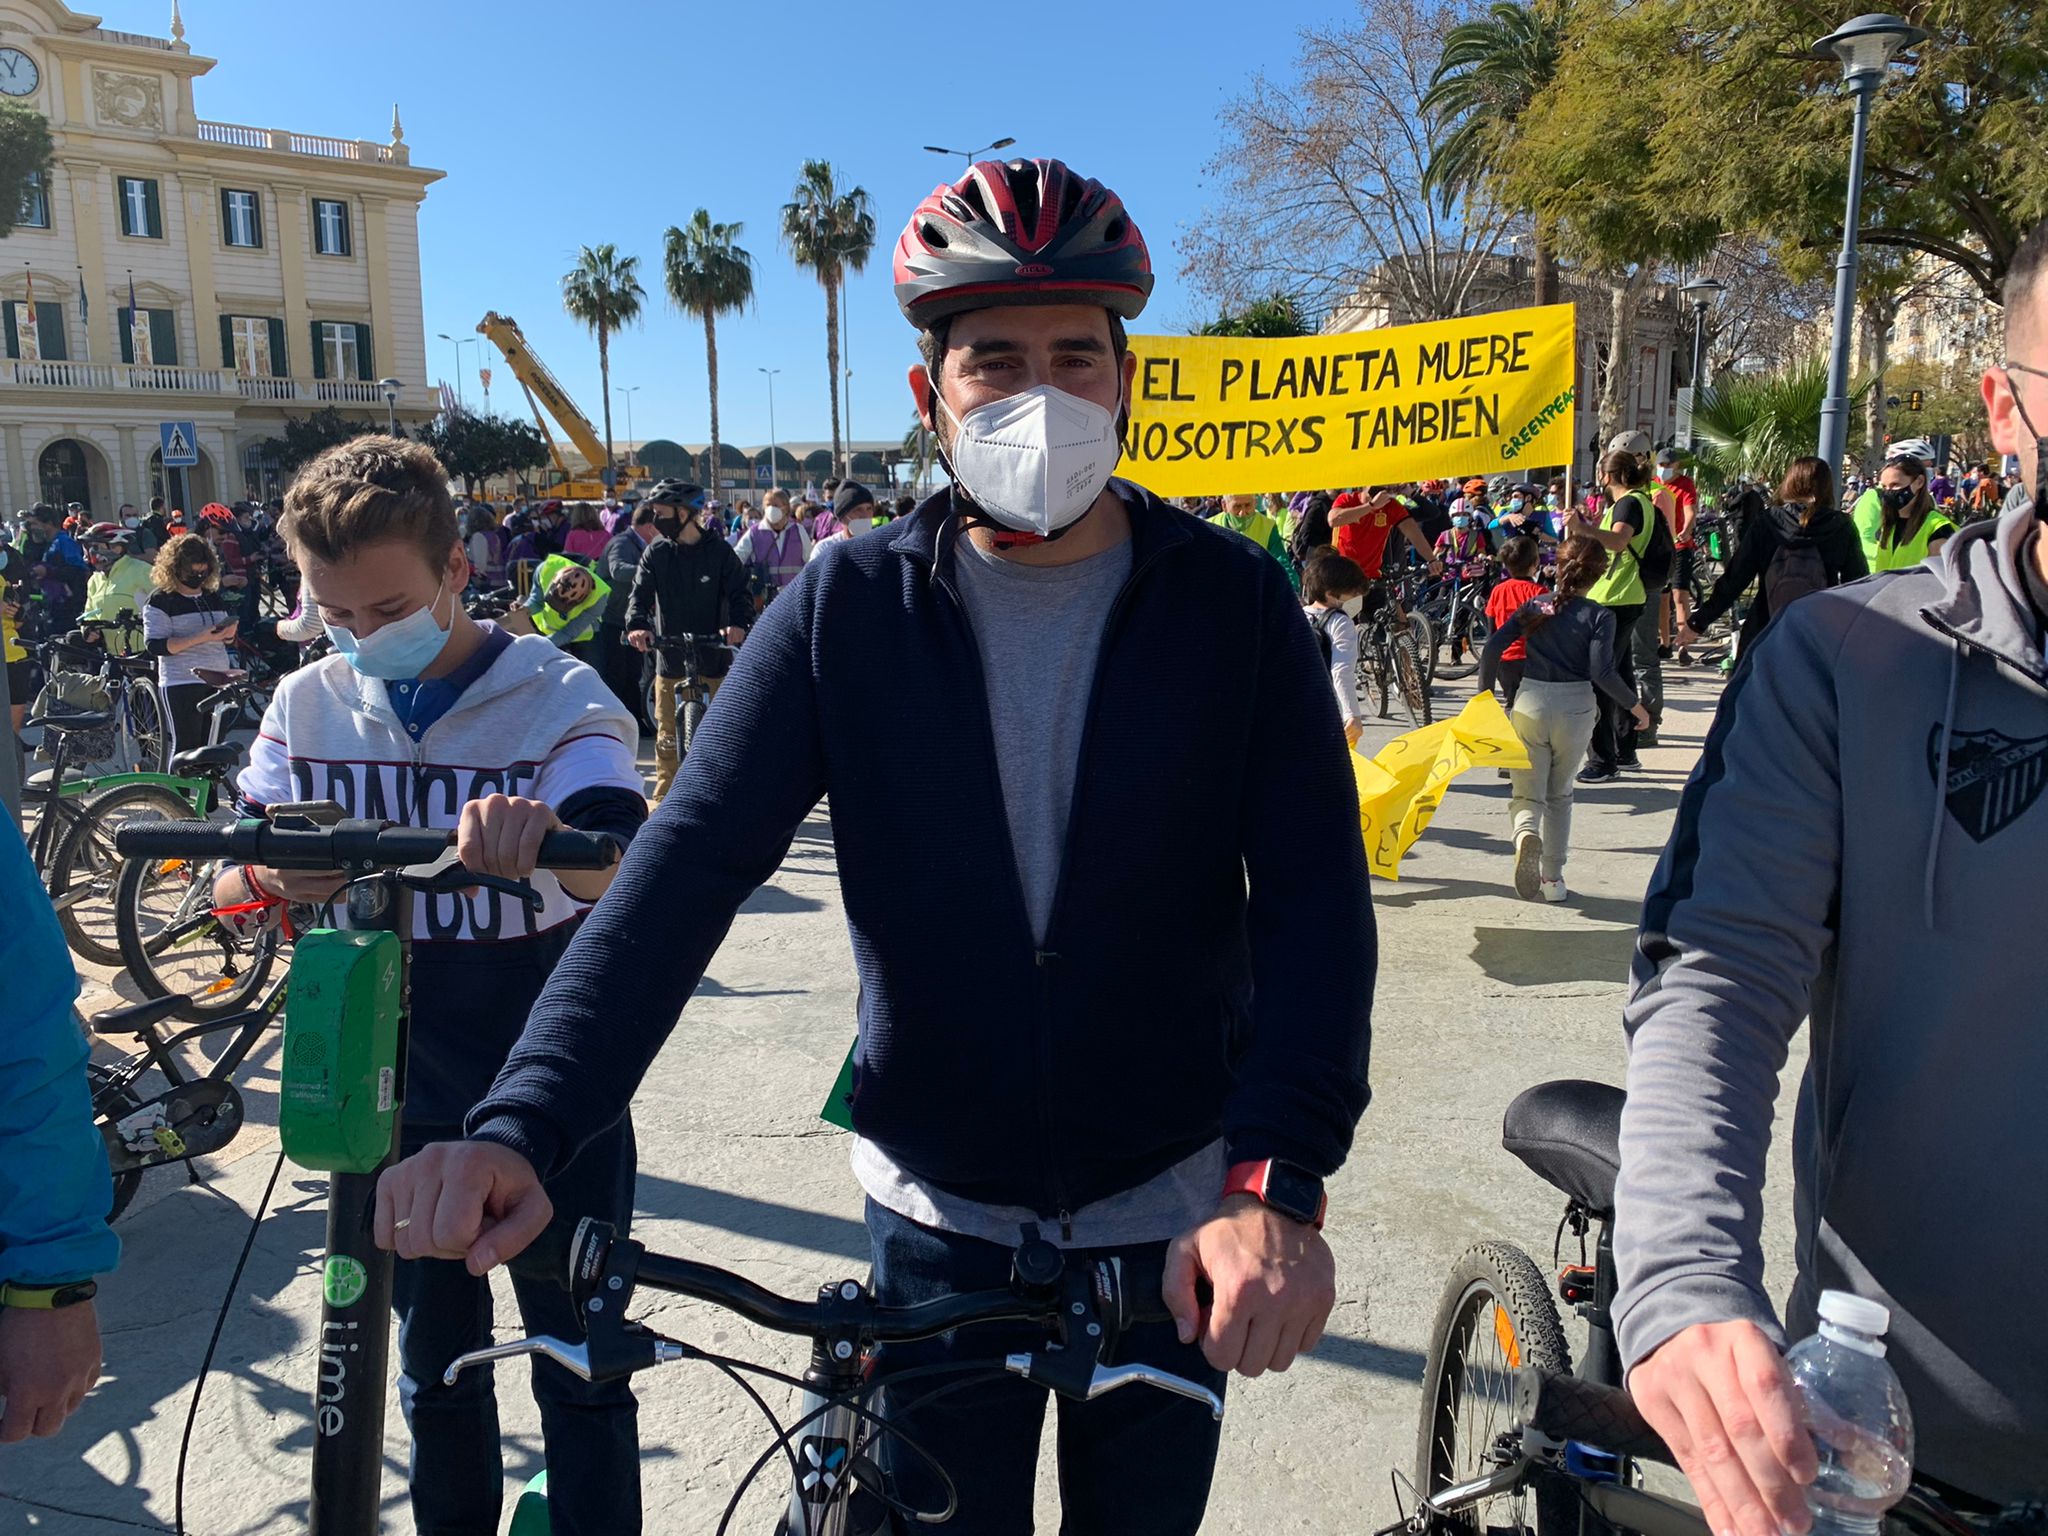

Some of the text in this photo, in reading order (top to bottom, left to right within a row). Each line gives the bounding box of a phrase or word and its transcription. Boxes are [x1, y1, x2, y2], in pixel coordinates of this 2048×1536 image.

[1142, 331, 1534, 402] EL PLANETA MUERE
[1122, 383, 1499, 462] NOSOTRXS TAMBIÉN
